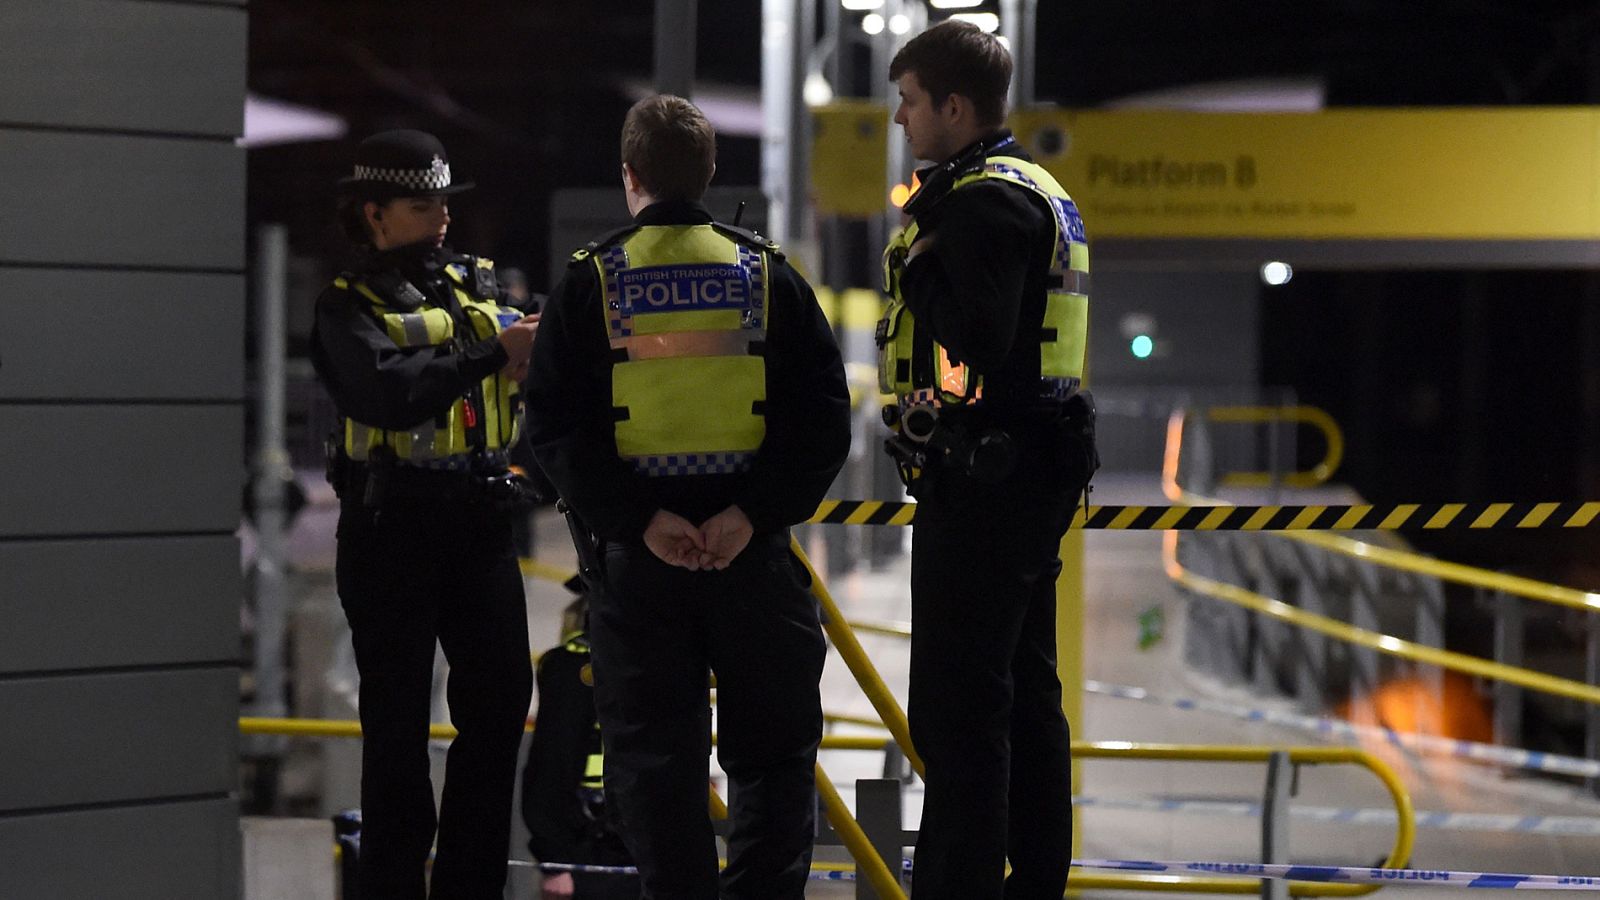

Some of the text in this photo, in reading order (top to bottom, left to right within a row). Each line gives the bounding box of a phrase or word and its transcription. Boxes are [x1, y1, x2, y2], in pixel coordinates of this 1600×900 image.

[1088, 154, 1227, 188] Platform
[623, 268, 742, 283] BRITISH TRANSPORT
[624, 279, 745, 308] POLICE
